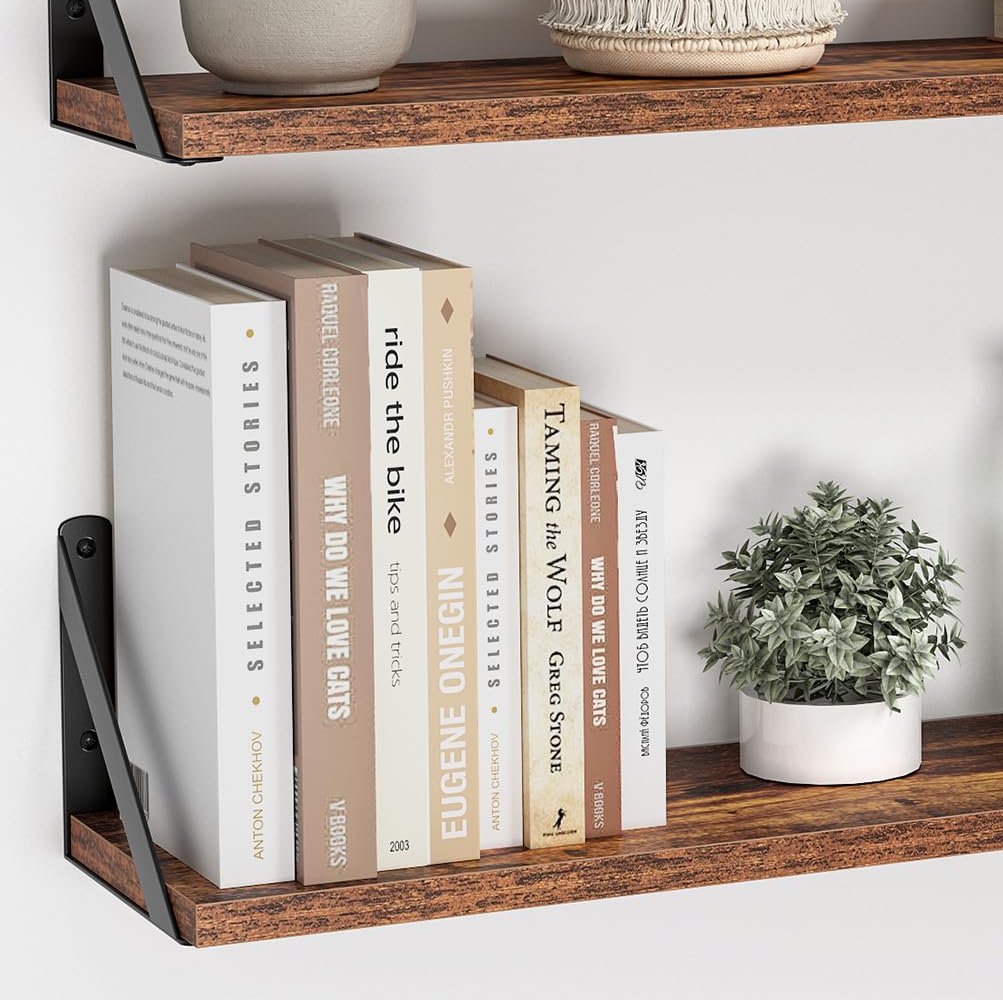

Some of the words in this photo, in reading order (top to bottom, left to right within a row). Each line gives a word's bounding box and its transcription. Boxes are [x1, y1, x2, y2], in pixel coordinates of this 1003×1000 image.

[384, 327, 404, 391] ride
[442, 347, 454, 409] PUSHKIN
[321, 348, 341, 429] CORLEONE
[242, 360, 262, 495] STORIES
[386, 400, 405, 455] the
[444, 412, 456, 485] ALEXANDR
[544, 403, 566, 514] TAMING
[323, 474, 348, 525] WHY
[387, 466, 406, 535] bike
[484, 452, 499, 554] STORIES
[589, 467, 601, 524] CORLEONE
[325, 530, 349, 562] DO
[545, 522, 562, 550] the
[245, 518, 264, 671] SELECTED
[325, 565, 350, 602] WE
[387, 562, 402, 595] tips
[545, 553, 568, 633] WOLF
[590, 555, 605, 592] WHY
[326, 606, 350, 662] LOVE
[389, 601, 403, 636] and
[437, 566, 465, 695] ONEGIN
[486, 572, 501, 689] SELECTED
[591, 595, 607, 617] DO
[591, 619, 606, 644] WE
[327, 664, 351, 721] CATS
[391, 641, 404, 688] tricks
[548, 650, 565, 706] GREG
[591, 647, 607, 686] LOVE
[592, 688, 608, 727] CATS
[251, 731, 264, 805] CHEKHOV
[490, 732, 500, 790] CHEKHOV
[549, 710, 566, 774] STONE
[439, 704, 468, 841] EUGENE
[253, 808, 265, 861] ANTON
[491, 791, 500, 831] ANTON
[389, 839, 411, 853] 2003
